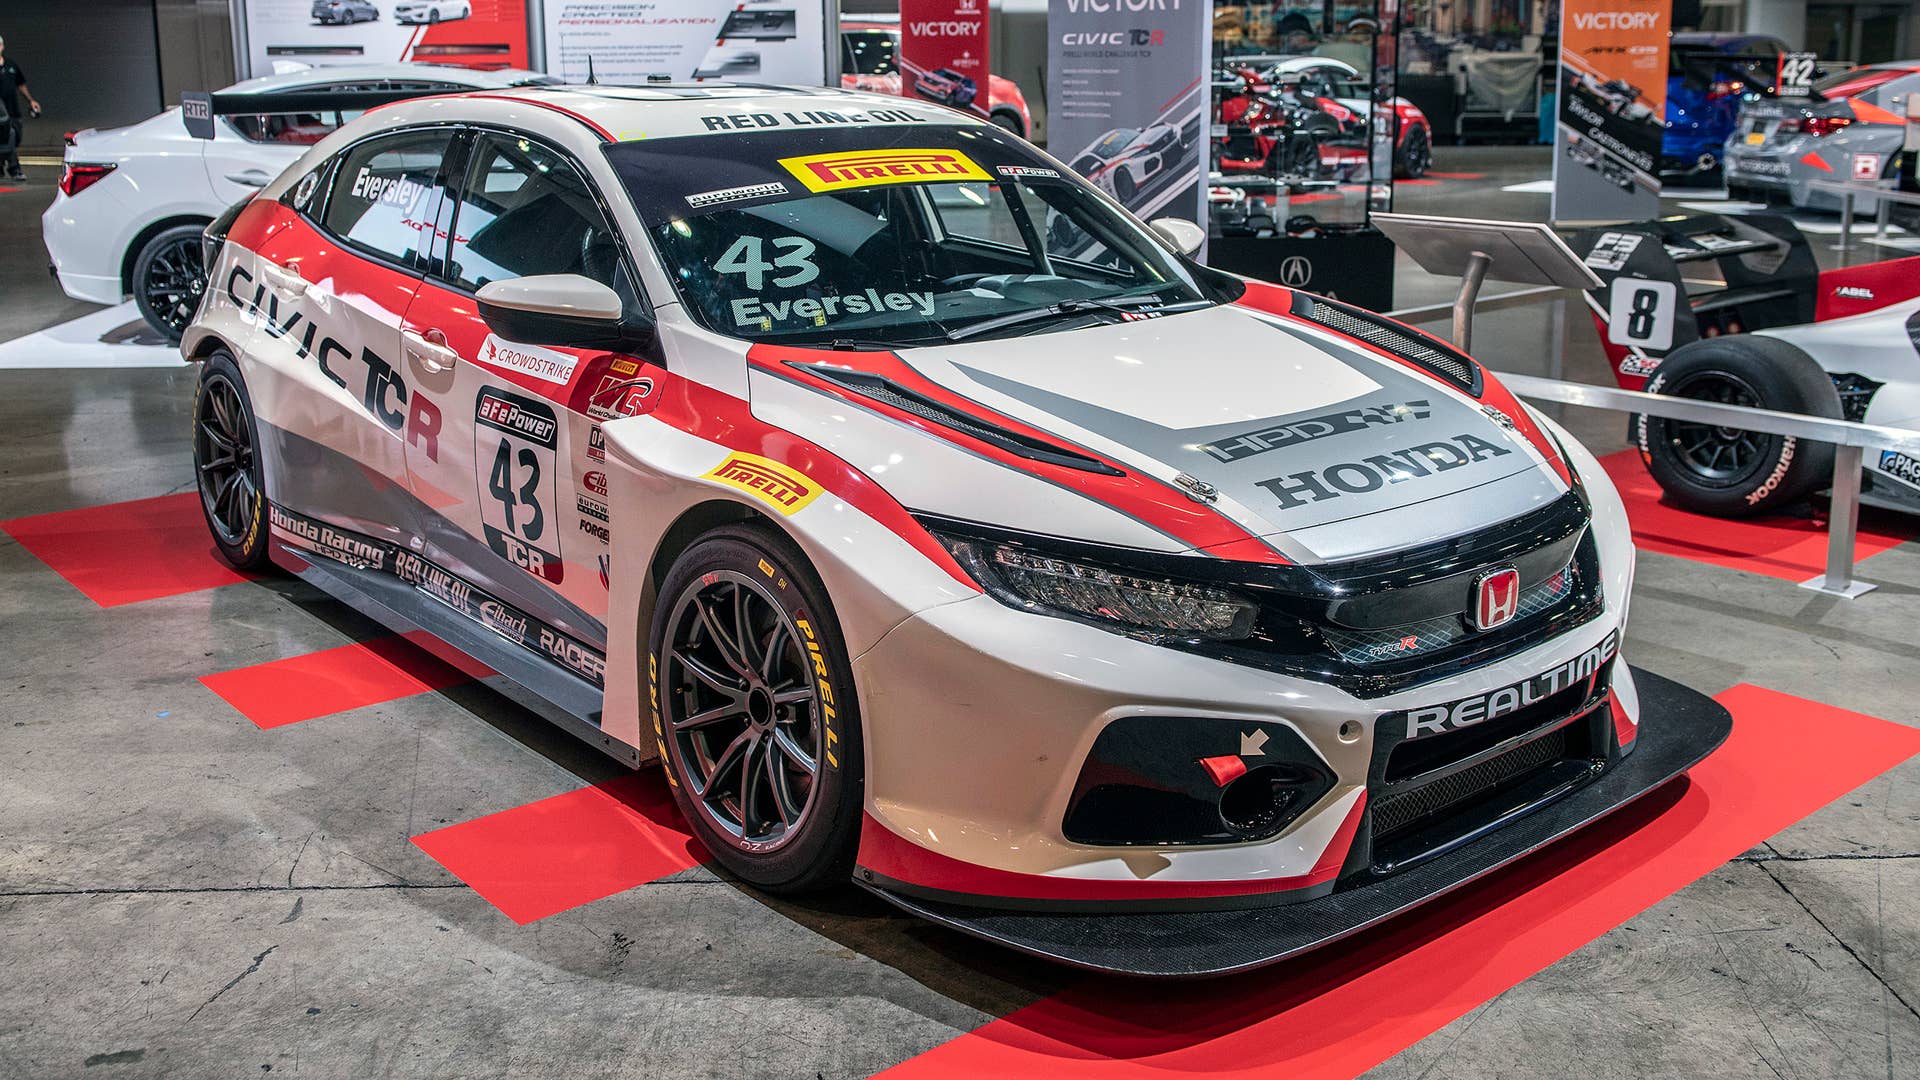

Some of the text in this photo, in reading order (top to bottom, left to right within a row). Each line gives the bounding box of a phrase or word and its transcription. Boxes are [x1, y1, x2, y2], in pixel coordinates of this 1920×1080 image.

[909, 22, 981, 36] VICTORY
[1062, 29, 1165, 46] CIVIC TCR
[1573, 12, 1660, 30] VICTORY
[1783, 58, 1815, 86] 42
[184, 101, 209, 118] RTR
[700, 109, 927, 132] RED LINE OIL
[351, 166, 425, 215] Eversley
[804, 154, 971, 184] PIRELLI
[712, 234, 820, 291] 43
[730, 288, 936, 327] Eversley
[1627, 288, 1659, 340] 8
[1840, 286, 1874, 298] ABEL
[227, 264, 352, 390] CIVIC
[498, 348, 573, 380] CROWDSTRIKE
[361, 345, 443, 465] TCR
[1207, 420, 1335, 461] HPD
[489, 436, 544, 542] 43
[712, 458, 809, 507] PIRELLI
[1254, 433, 1513, 510] HONDA
[1745, 436, 1797, 506] Hankook
[578, 496, 610, 515] eurow
[269, 505, 385, 570] Honda Racing
[501, 532, 546, 578] TCR
[395, 551, 472, 615] RED LINE OIL
[479, 600, 528, 636] Eibach
[796, 619, 839, 769] PIRELLI
[1405, 631, 1617, 740] REALTIME
